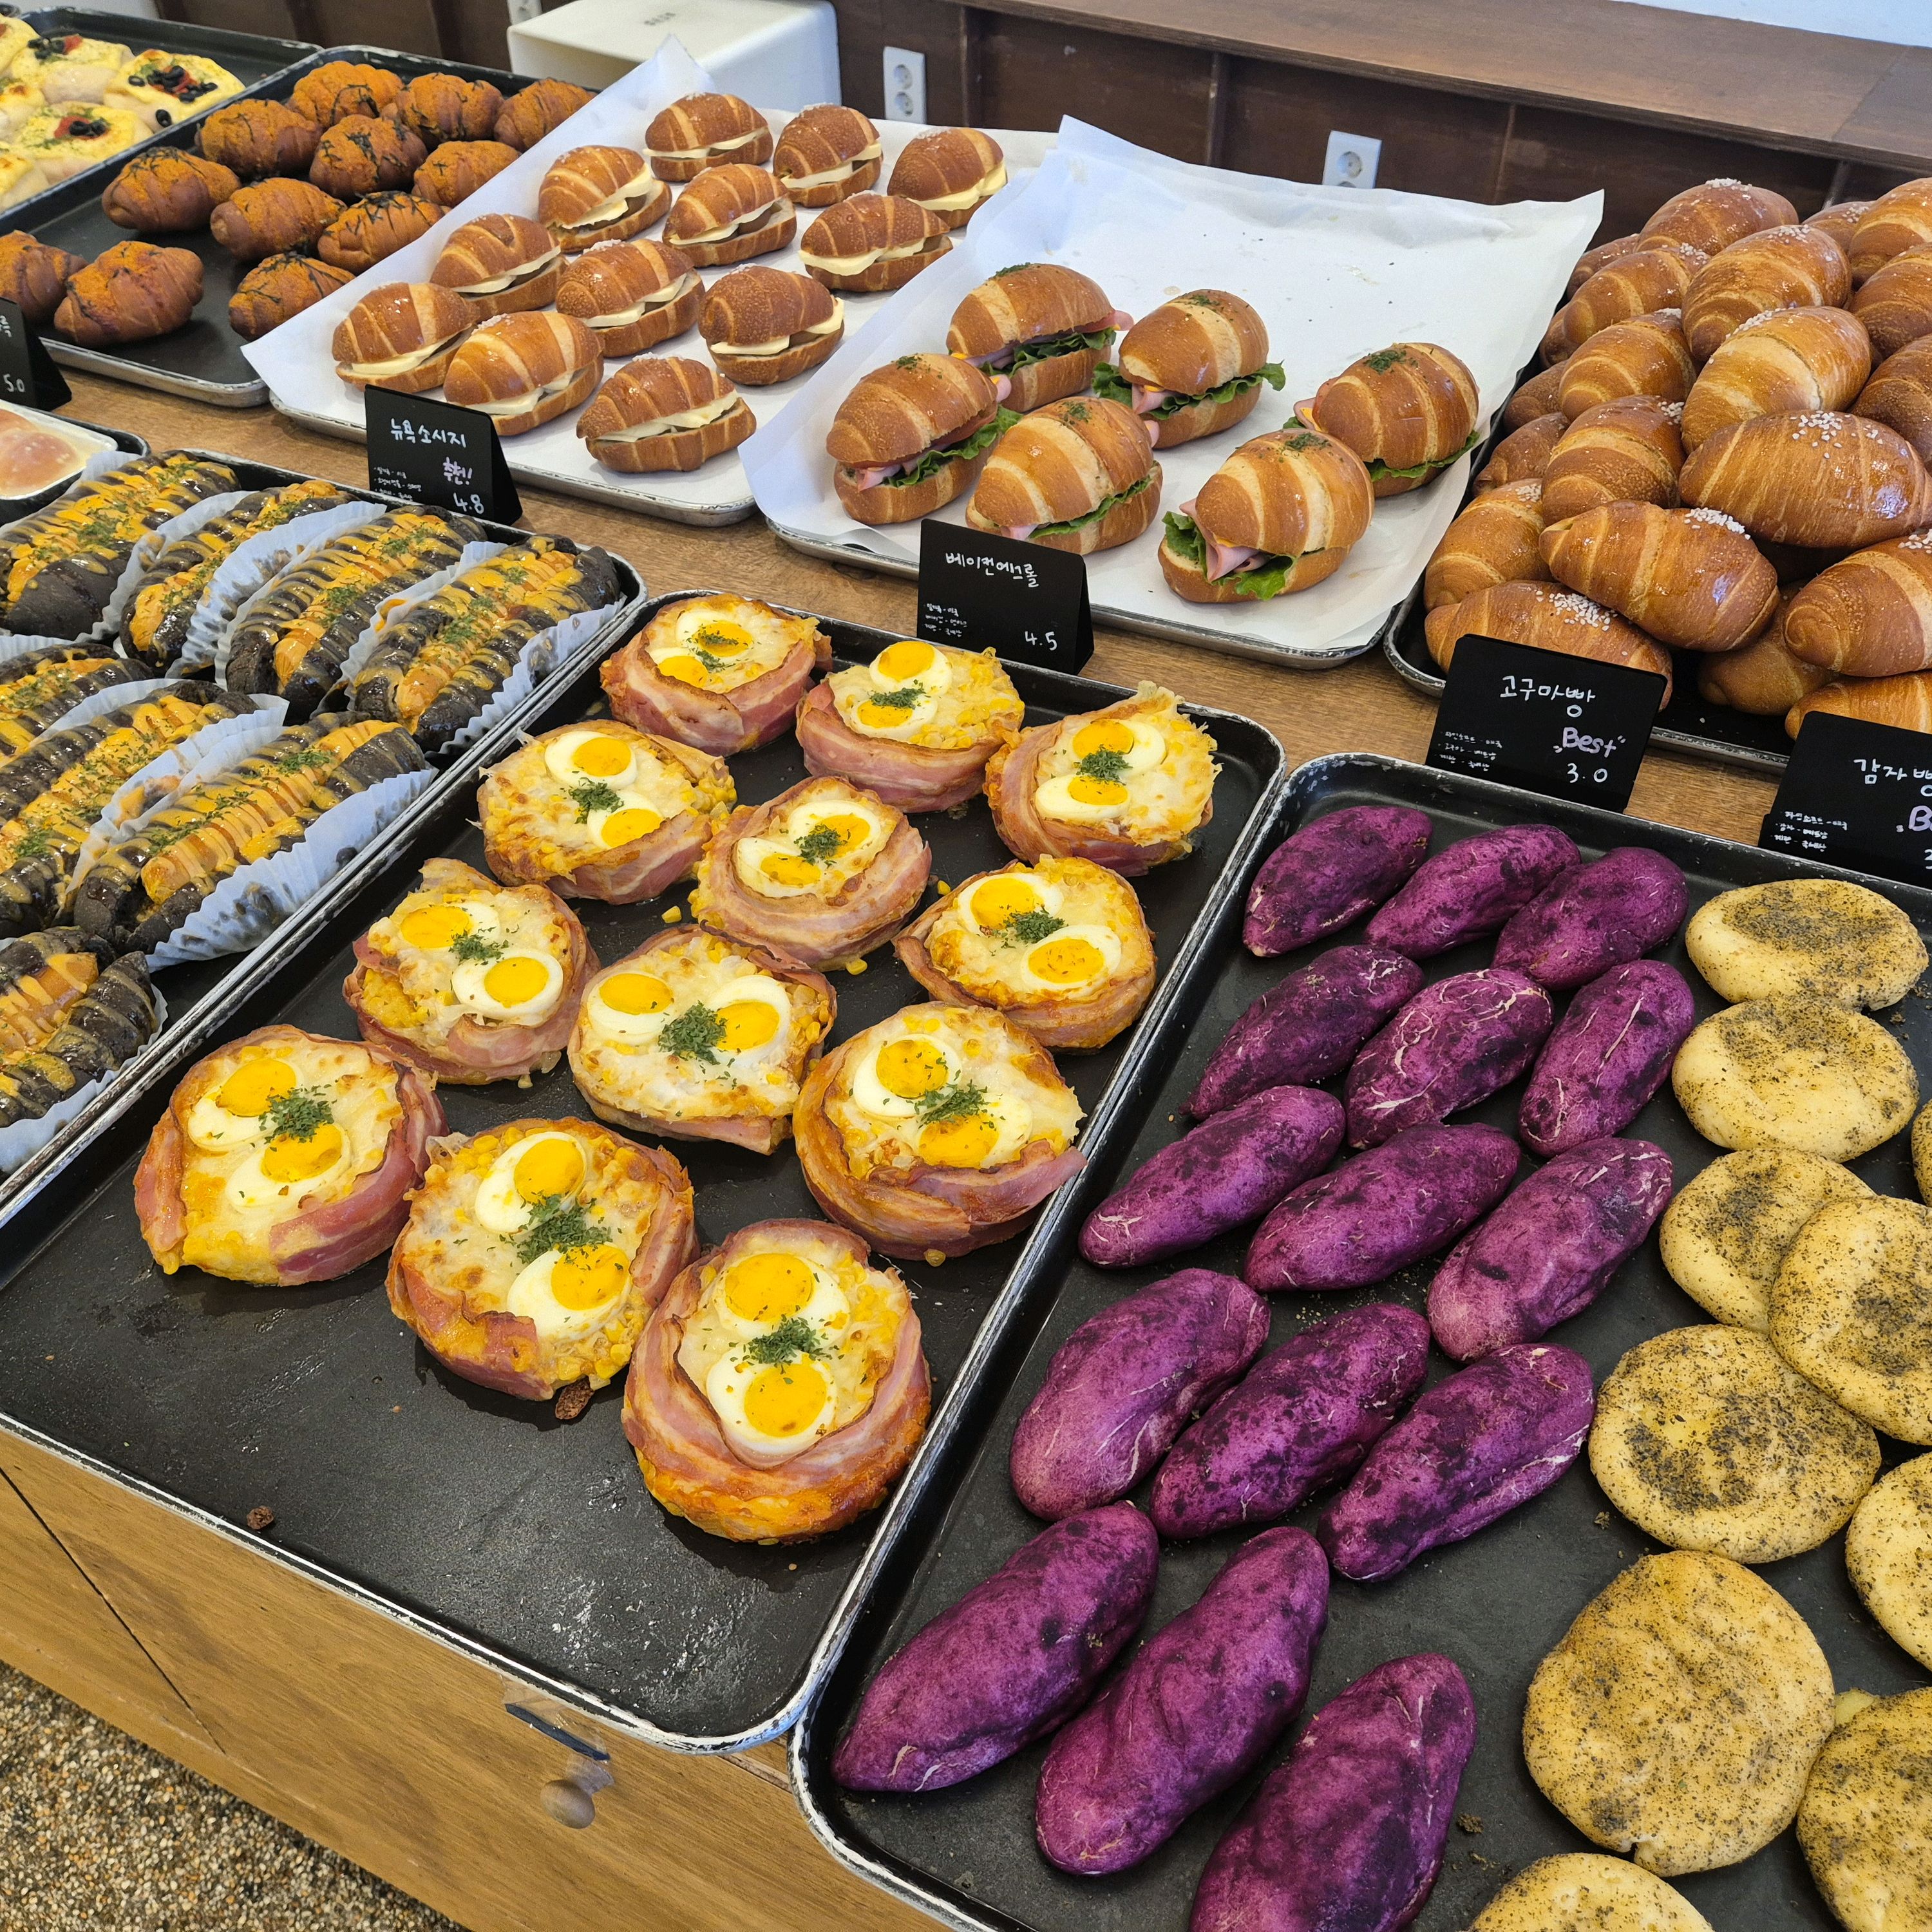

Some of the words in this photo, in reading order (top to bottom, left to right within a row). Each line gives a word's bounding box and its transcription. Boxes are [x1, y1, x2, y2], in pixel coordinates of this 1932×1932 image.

[453, 492, 484, 514] 4.8
[1025, 630, 1057, 650] 4.5
[1500, 675, 1596, 717] 고구마빵
[1444, 743, 1464, 752] 고구마
[1567, 763, 1608, 784] 3.0
